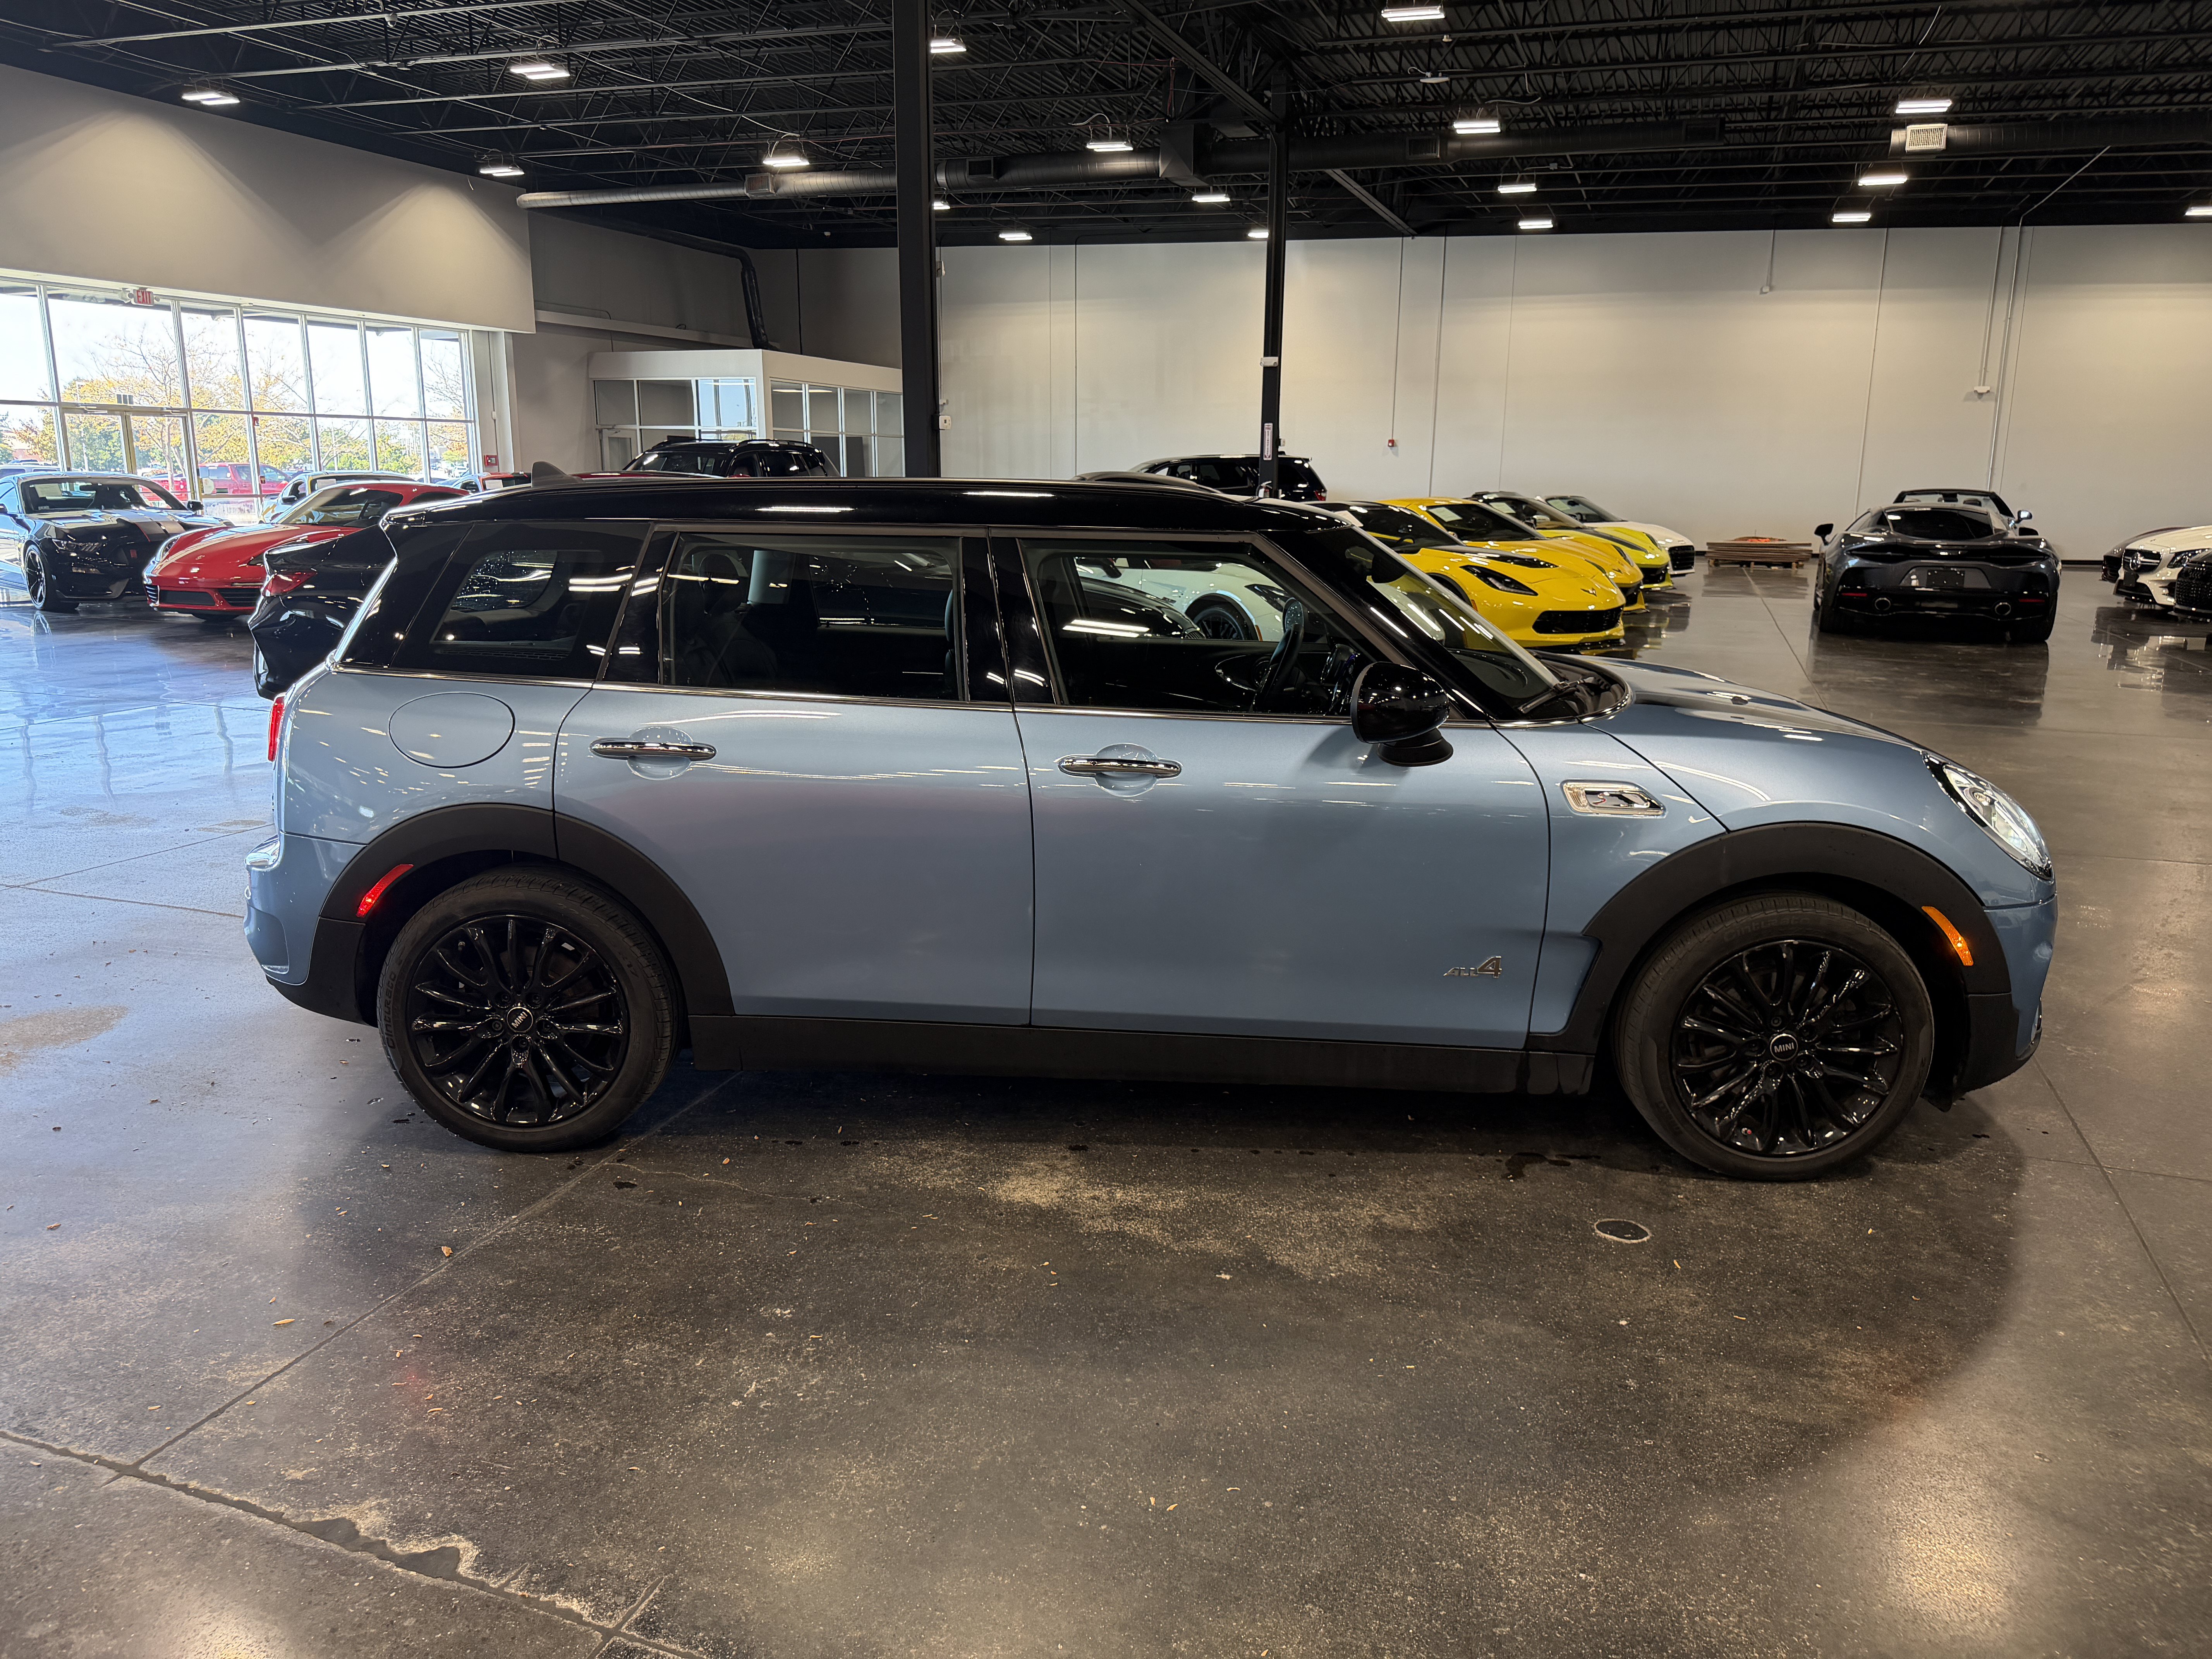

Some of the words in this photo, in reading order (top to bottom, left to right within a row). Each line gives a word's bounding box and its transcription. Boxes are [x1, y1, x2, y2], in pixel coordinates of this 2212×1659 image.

[137, 290, 151, 304] EXIT
[1592, 792, 1607, 805] S
[1443, 956, 1502, 978] ALL4
[511, 1011, 528, 1028] MINI
[1774, 1042, 1795, 1053] MINI
